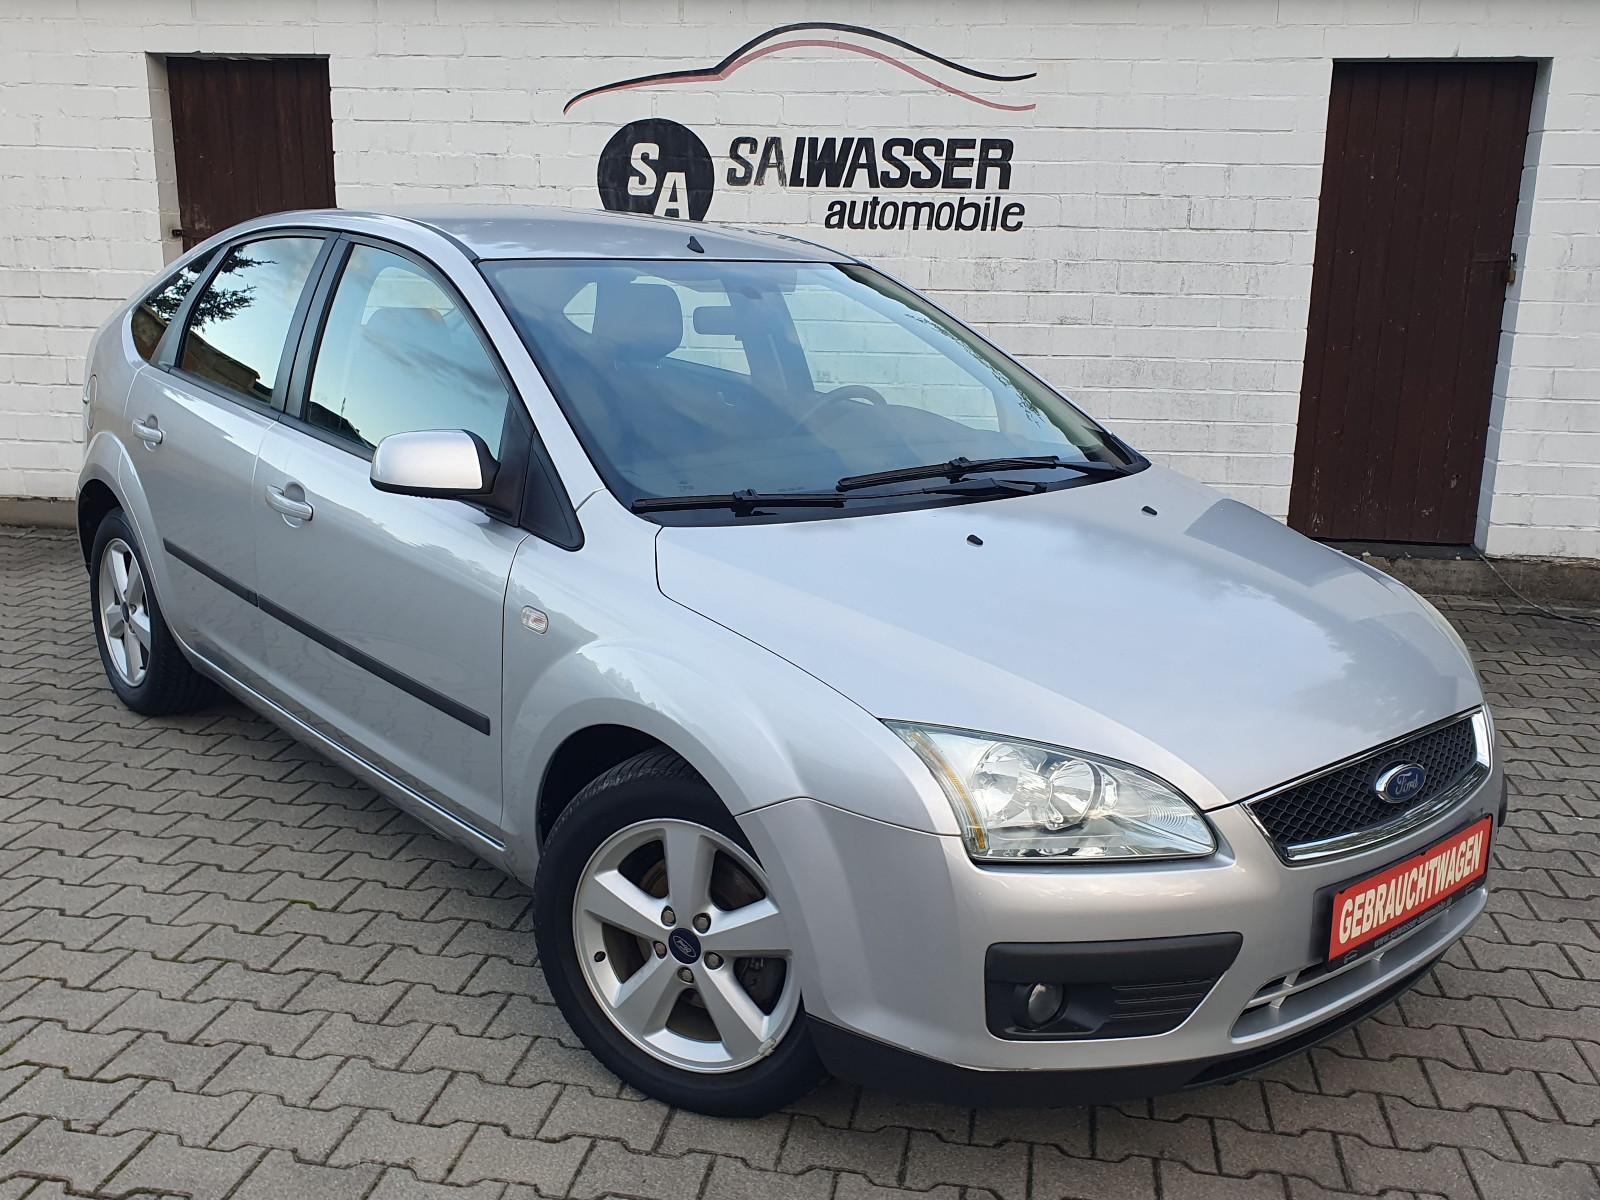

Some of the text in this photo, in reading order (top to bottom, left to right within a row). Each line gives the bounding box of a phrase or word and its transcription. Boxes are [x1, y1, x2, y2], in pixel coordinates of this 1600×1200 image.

[627, 142, 691, 220] SA
[726, 136, 1014, 190] SALWASSER
[824, 196, 1025, 232] automobile
[1396, 772, 1418, 795] Ford
[1338, 829, 1484, 945] GEBRAUCHTWAGEN
